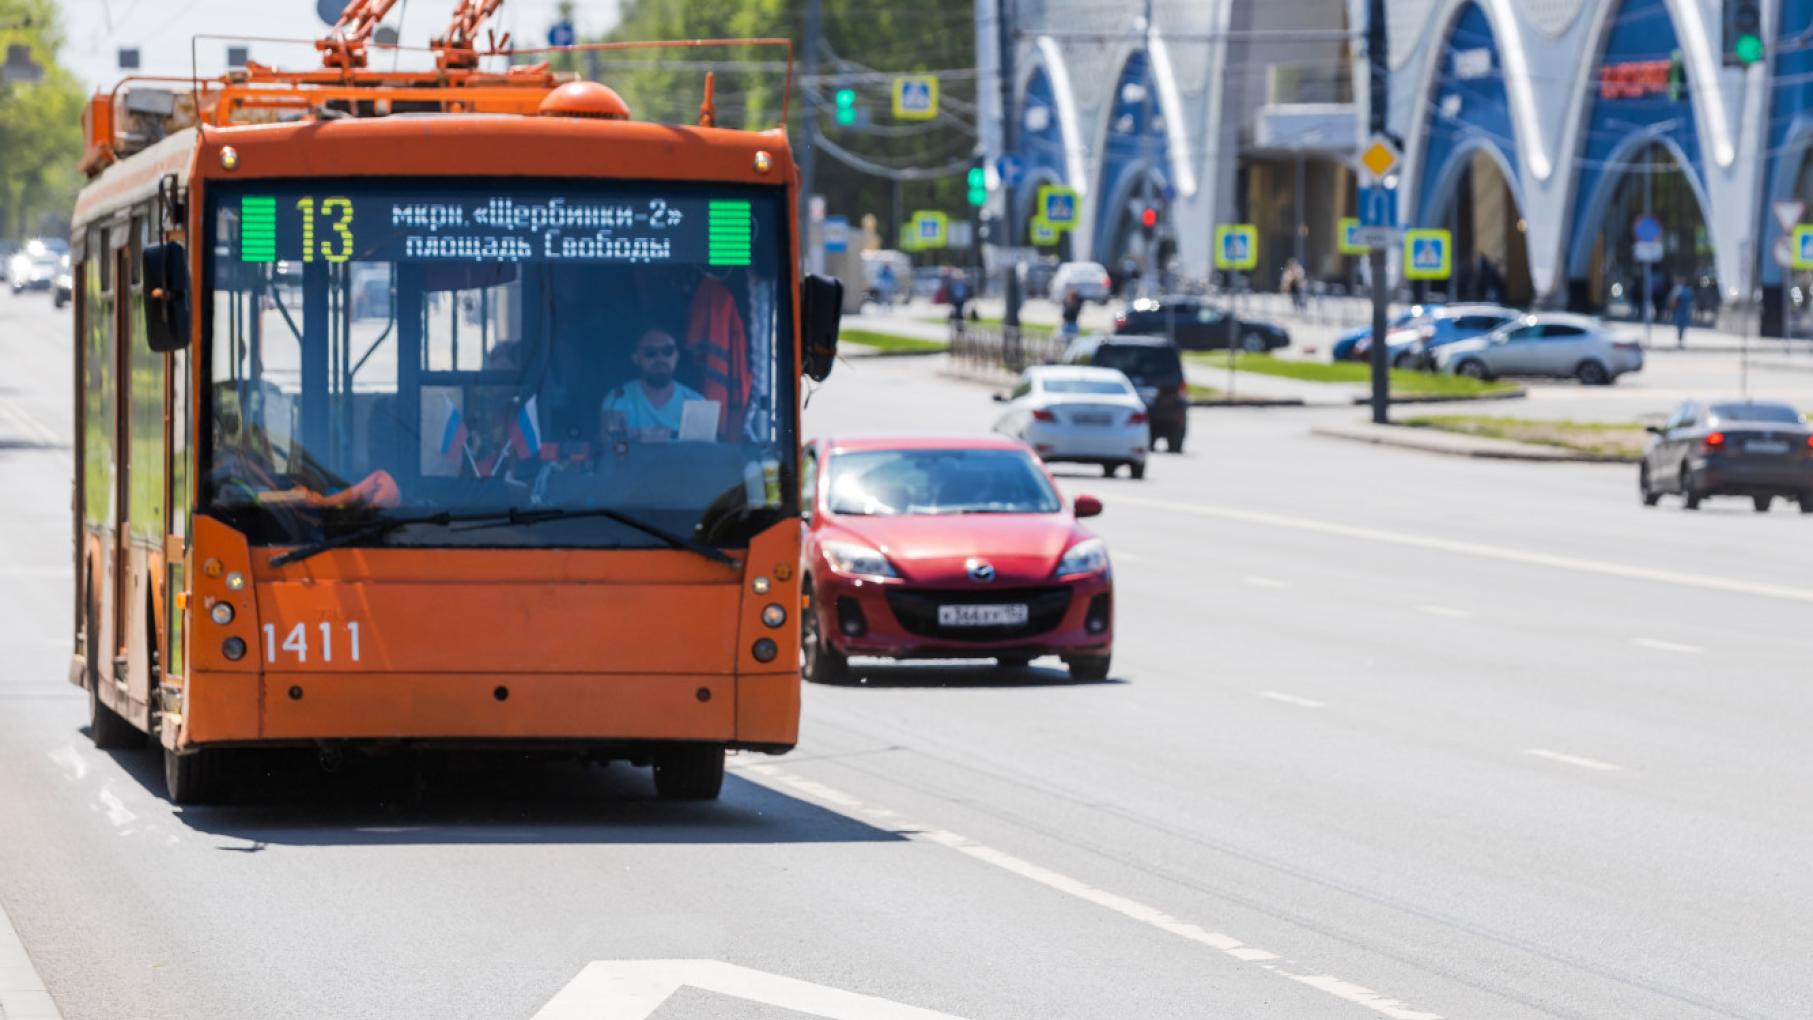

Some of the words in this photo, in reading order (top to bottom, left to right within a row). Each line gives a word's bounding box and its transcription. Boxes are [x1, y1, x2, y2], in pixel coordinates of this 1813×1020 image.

[296, 196, 353, 262] 13
[393, 203, 470, 231] мкрн.
[473, 197, 683, 232] «Щербинки-2»
[406, 236, 531, 261] площадь
[545, 229, 670, 262] Свободы
[263, 621, 360, 663] 1411
